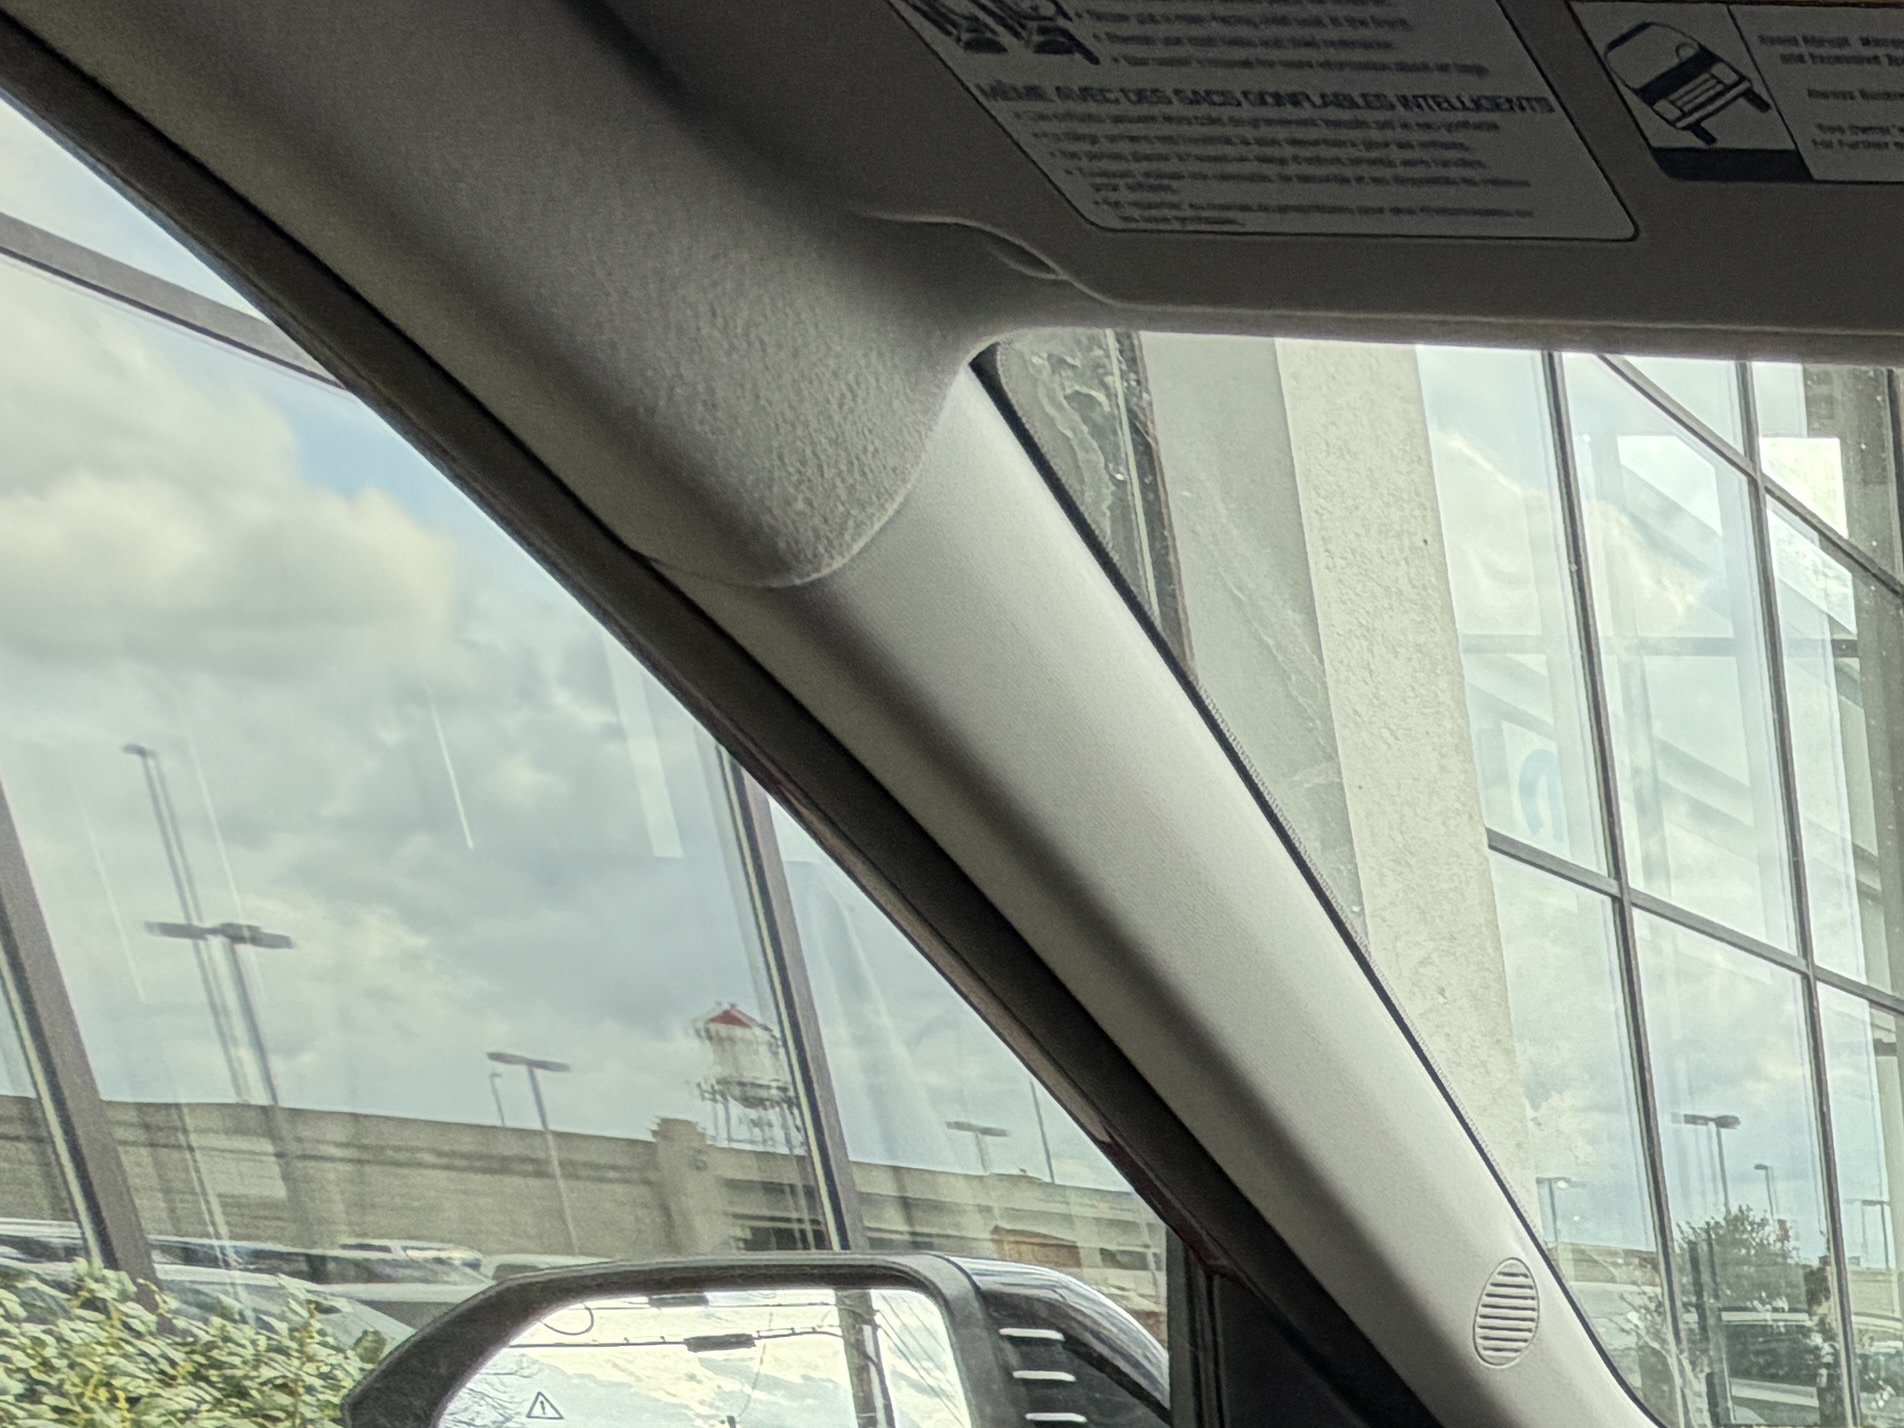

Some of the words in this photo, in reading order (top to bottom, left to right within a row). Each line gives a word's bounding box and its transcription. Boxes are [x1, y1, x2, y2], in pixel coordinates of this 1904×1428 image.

[1054, 85, 1122, 106] AVEC
[1126, 87, 1176, 107] DES
[1179, 88, 1238, 109] SACS
[1240, 89, 1396, 113] GONFLABLES
[1396, 92, 1556, 115] INTELLIGENTS
